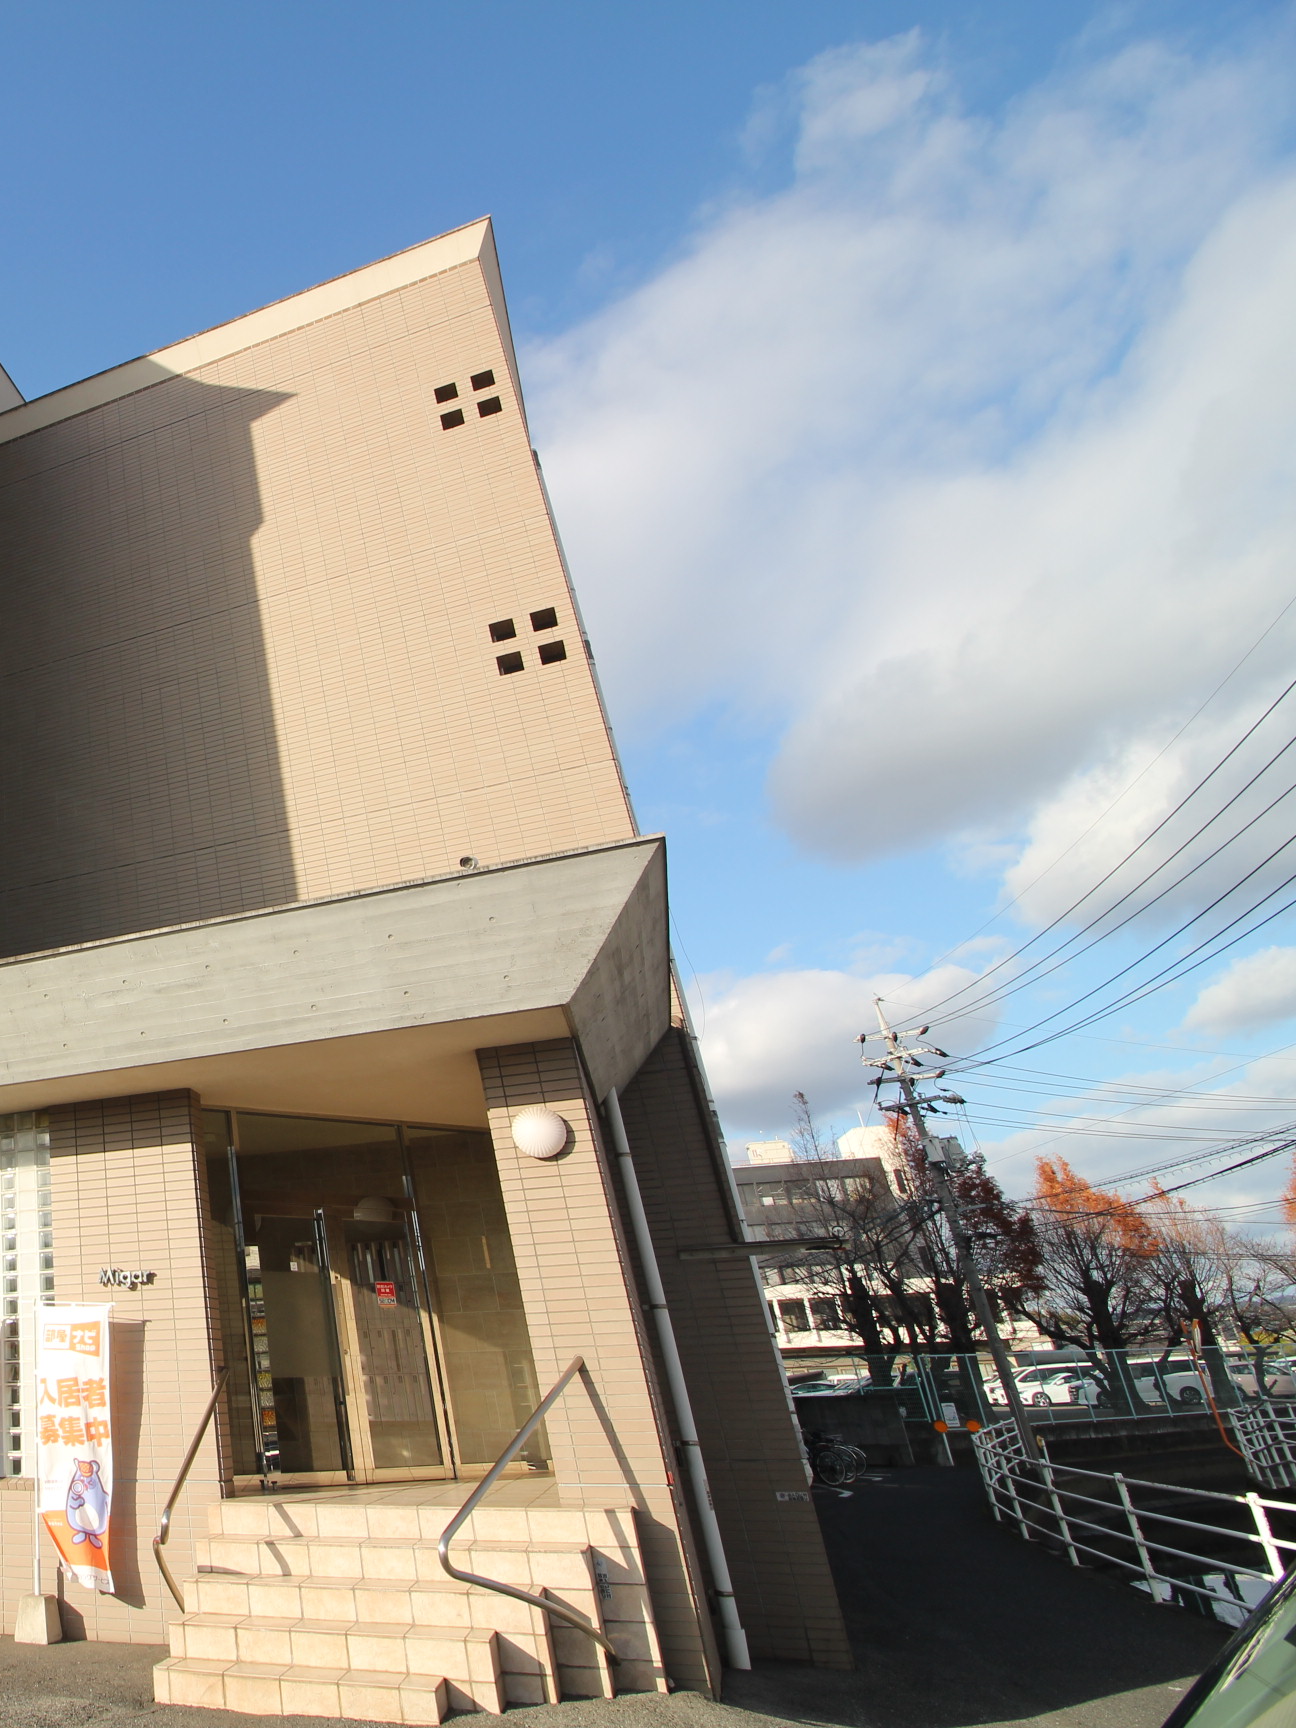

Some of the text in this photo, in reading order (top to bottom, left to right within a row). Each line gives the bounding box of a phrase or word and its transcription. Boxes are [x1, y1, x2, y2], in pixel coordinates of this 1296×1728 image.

[98, 1266, 151, 1288] Migar
[45, 1328, 97, 1345] 部屋ナビ
[39, 1376, 107, 1409] 入居者
[39, 1413, 111, 1448] 募集中
